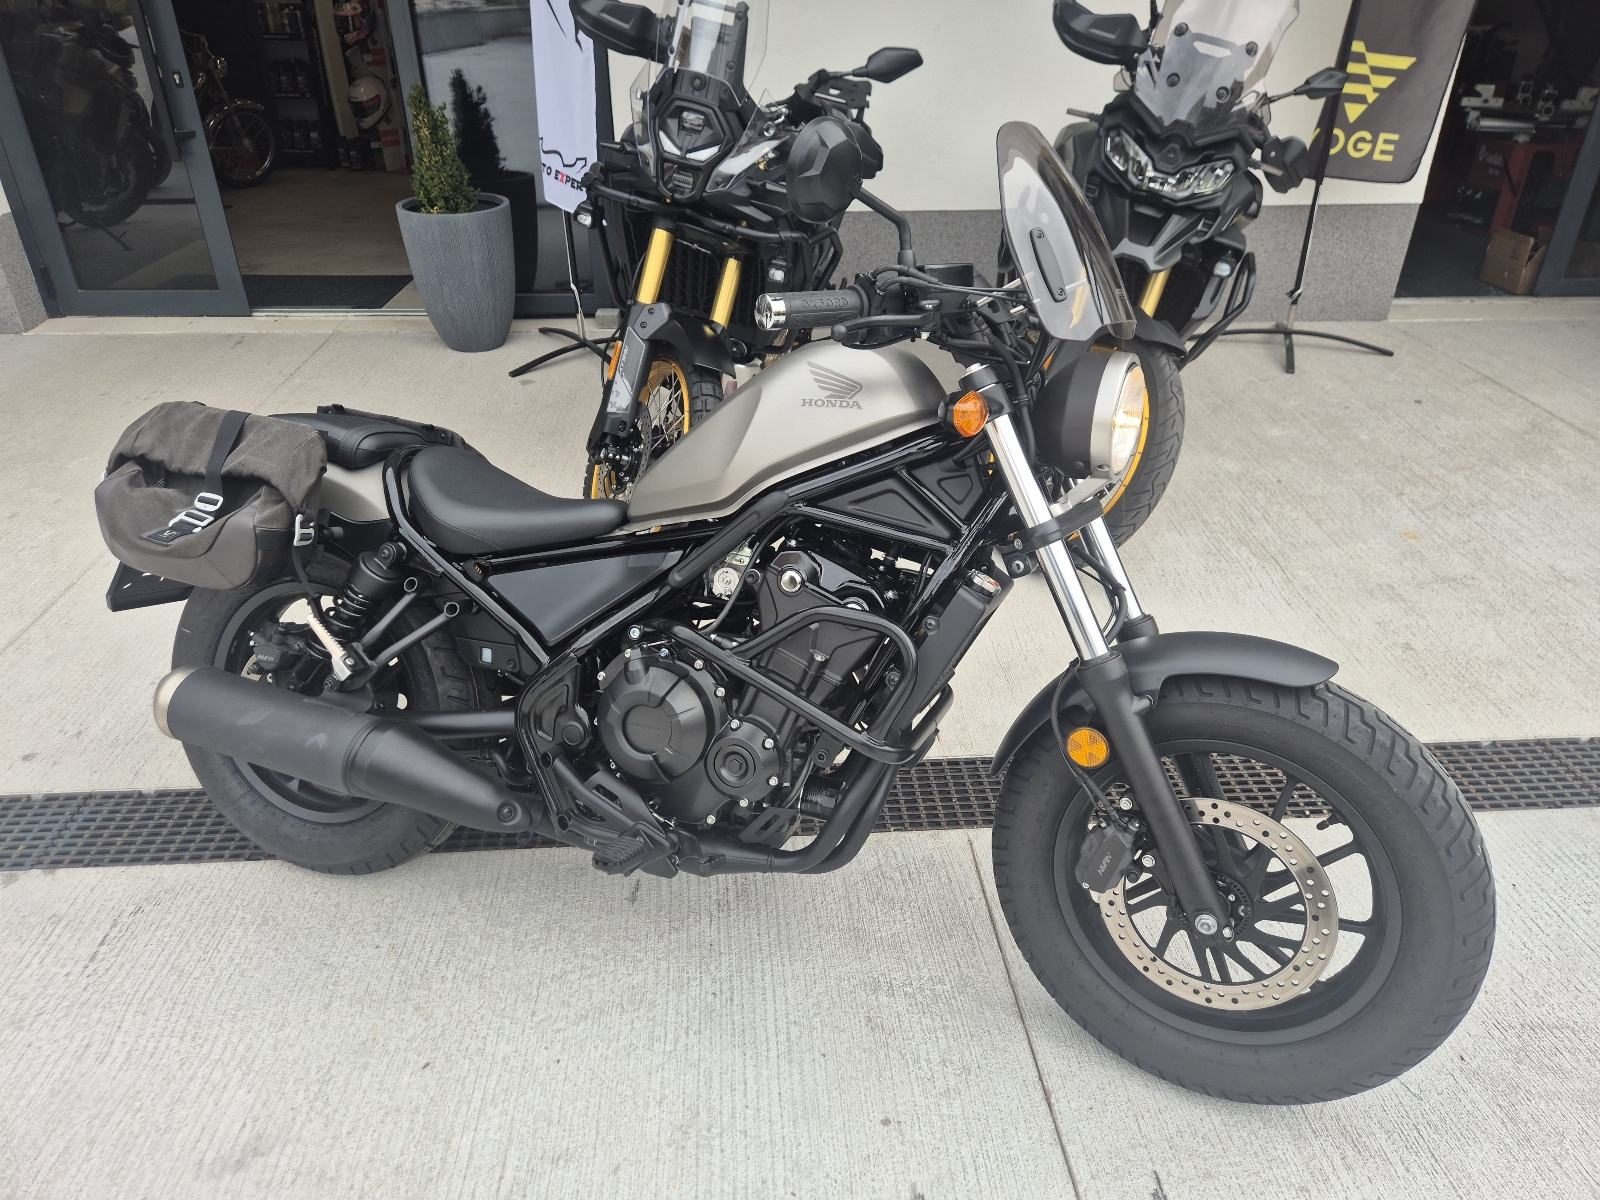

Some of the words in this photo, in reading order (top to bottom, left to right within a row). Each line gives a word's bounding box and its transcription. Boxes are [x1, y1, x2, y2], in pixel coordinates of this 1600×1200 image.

[1312, 128, 1400, 162] OGE
[800, 297, 849, 310] OXFORD
[800, 398, 863, 410] HONDA
